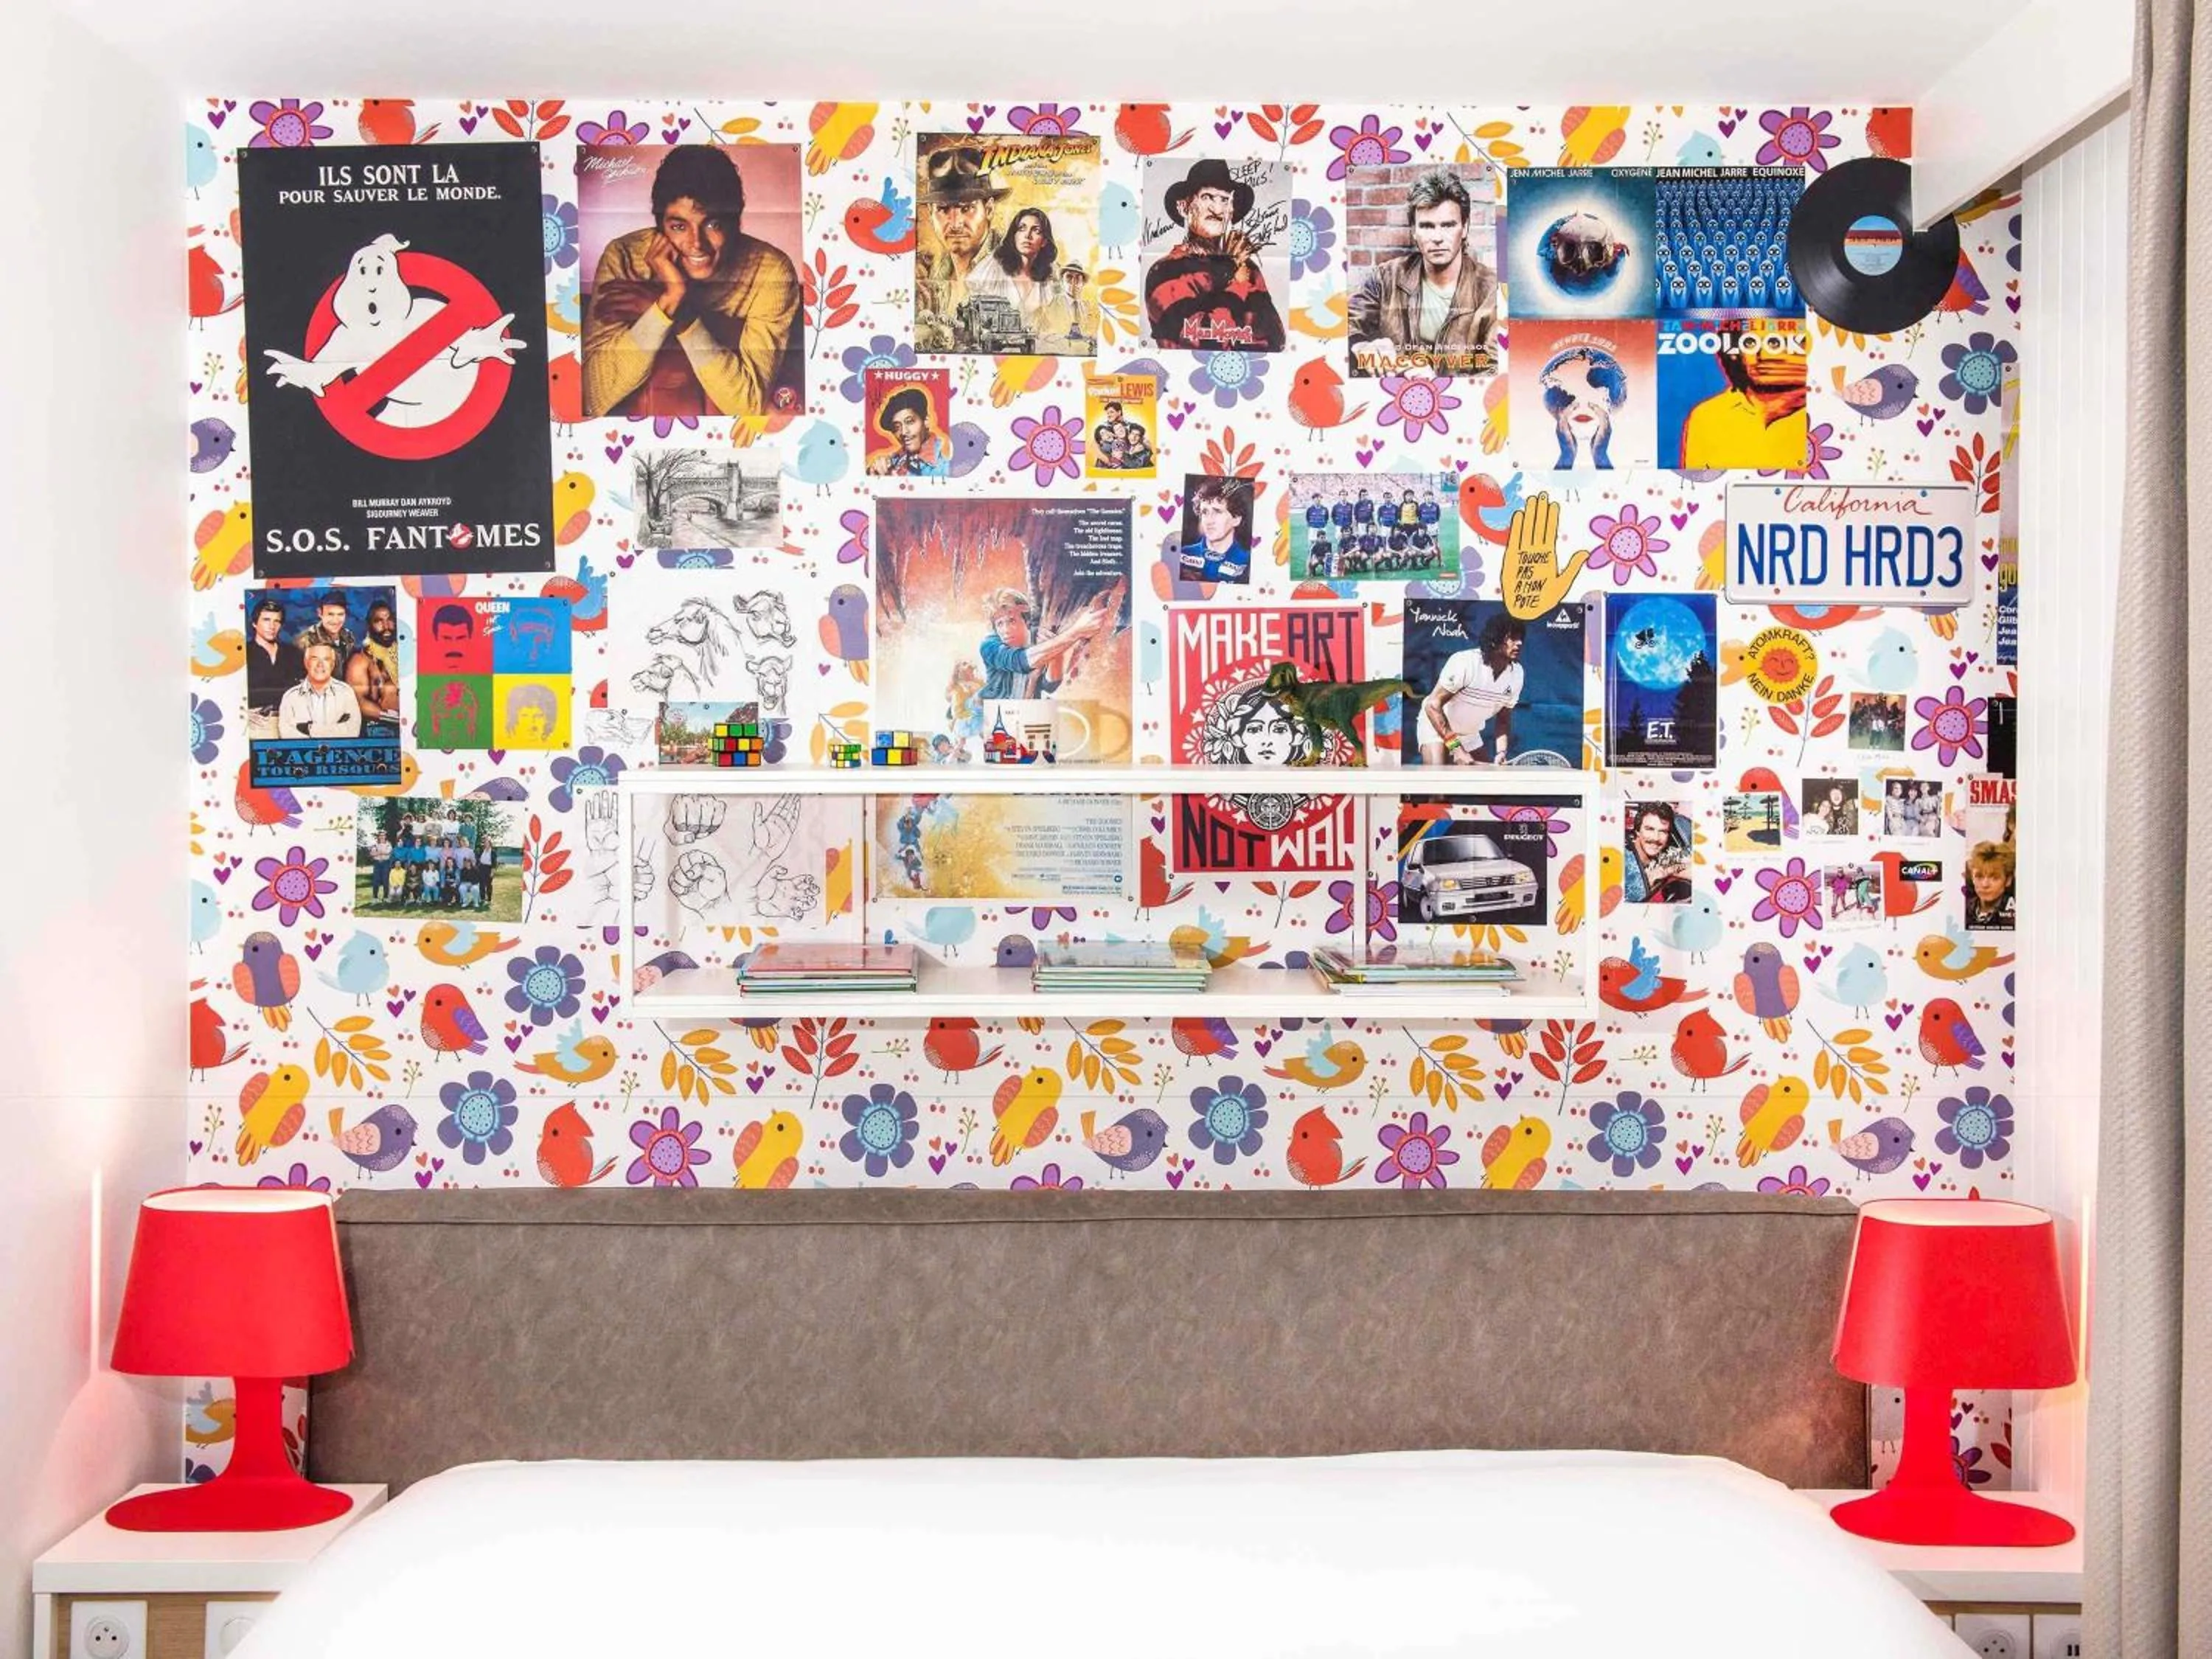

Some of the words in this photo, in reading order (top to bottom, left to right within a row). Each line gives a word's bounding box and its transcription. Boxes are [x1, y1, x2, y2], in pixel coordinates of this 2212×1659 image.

[319, 166, 352, 186] ILS
[364, 164, 421, 185] SONT
[433, 163, 460, 184] LA
[1531, 169, 1565, 178] MICHEL
[1656, 169, 1680, 178] JEAN
[1682, 168, 1718, 178] MICHEL
[1719, 168, 1747, 177] JARRE
[1753, 167, 1804, 176] EQUINOXE
[279, 189, 326, 204] POUR
[333, 189, 399, 203] SAUVER
[407, 188, 428, 201] LE
[437, 187, 502, 201] MONDE.
[1658, 333, 1806, 355] ZOOLOOK
[885, 371, 928, 381] HUGGY
[1121, 383, 1154, 397] LEWIS
[1783, 486, 1933, 519] California
[408, 508, 439, 517] WEAVER
[266, 529, 350, 553] S.O.S.
[1738, 523, 1828, 585] NRD
[1846, 524, 1963, 588] HRD3
[1516, 566, 1534, 579] PAS
[475, 601, 510, 613] QUEEN
[1431, 622, 1469, 640] Noah
[1748, 629, 1815, 660] ATOMKRAFT?
[1178, 613, 1283, 714] MAKE
[1287, 611, 1358, 683] ART
[1747, 672, 1773, 700] NEIN
[1777, 673, 1815, 702] DANKE
[1646, 720, 1676, 739] E.T.
[257, 748, 401, 765] L'AGENCE
[316, 763, 402, 776] RISQUS
[1180, 793, 1265, 868] NOT
[1902, 866, 1938, 876] CANAL+
